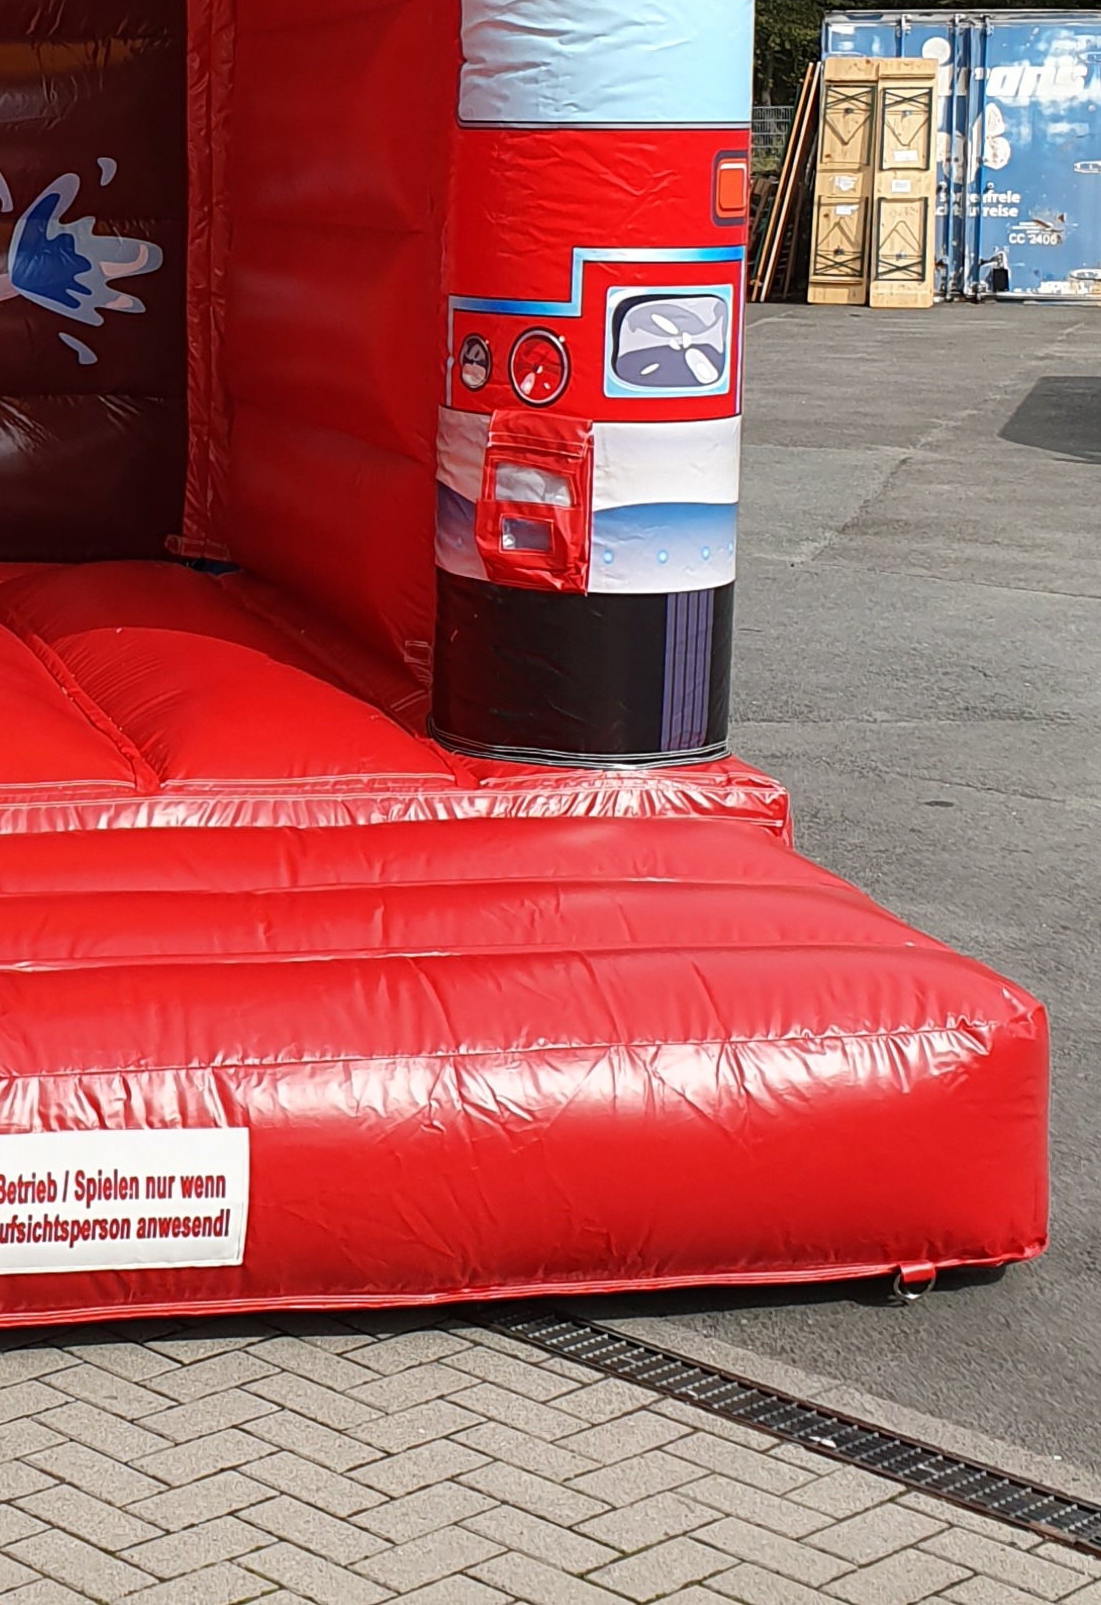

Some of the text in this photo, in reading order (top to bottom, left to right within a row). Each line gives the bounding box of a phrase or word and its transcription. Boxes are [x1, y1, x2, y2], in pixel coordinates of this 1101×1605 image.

[1009, 233, 1026, 244] CC
[62, 1170, 69, 1203] /
[74, 1169, 139, 1209] Spielen
[146, 1175, 175, 1199] nur
[180, 1174, 226, 1198] wenn
